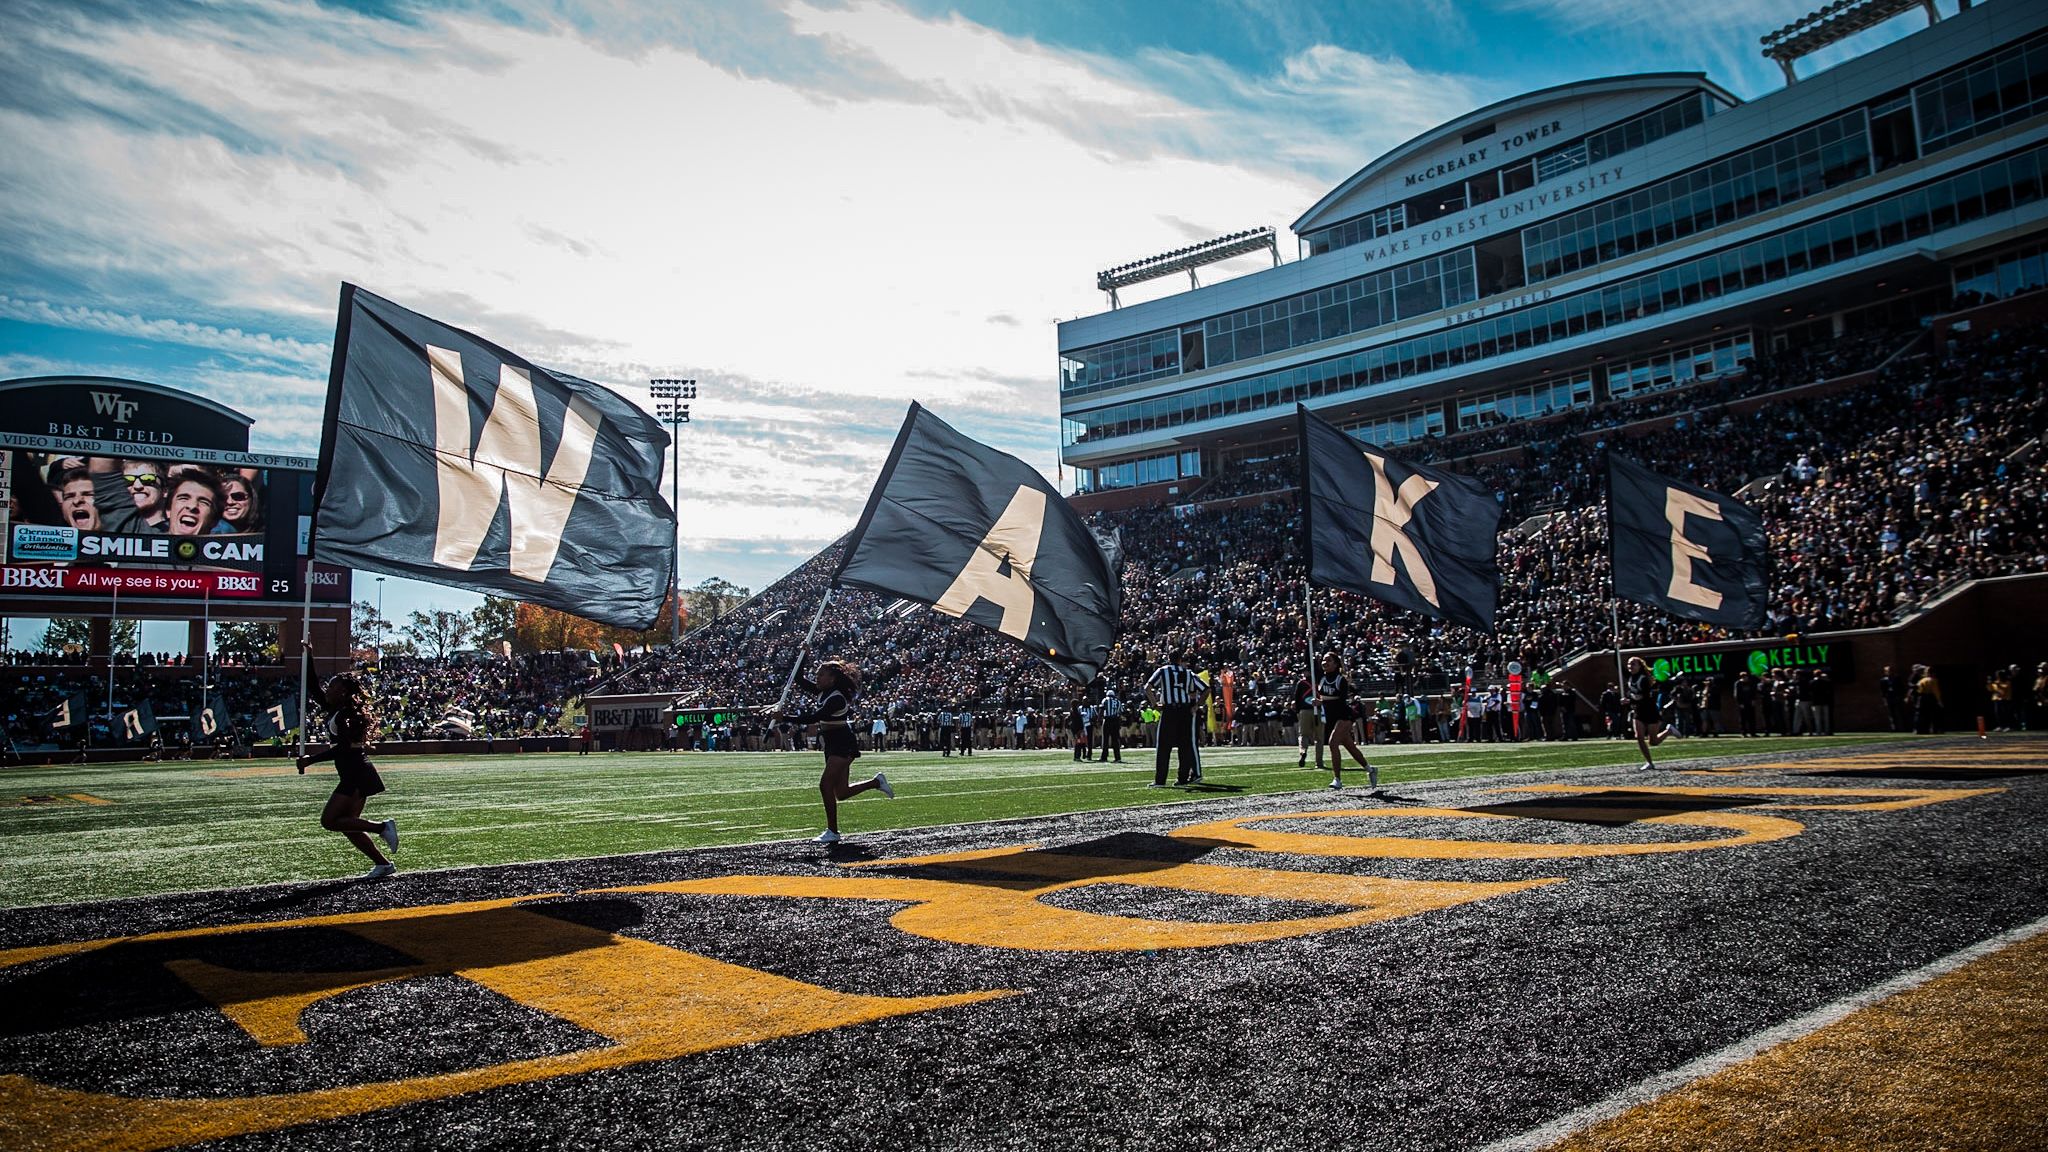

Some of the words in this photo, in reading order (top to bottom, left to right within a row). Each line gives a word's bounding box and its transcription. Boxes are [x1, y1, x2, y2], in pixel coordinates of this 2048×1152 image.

[1404, 148, 1488, 187] McCREARY
[1501, 120, 1562, 152] TOWER
[1363, 238, 1411, 263] WAKE
[1420, 213, 1489, 246] FOREST
[1499, 167, 1625, 220] UNIVERSITY
[1446, 307, 1487, 326] BB&T
[1501, 289, 1552, 311] FIELD
[90, 391, 139, 424] WF
[48, 422, 104, 438] BB&T
[116, 428, 174, 444] FIELD
[3, 434, 48, 447] VIDEO
[55, 439, 102, 451] BOARD
[113, 443, 185, 458] HONORING
[192, 450, 217, 461] THE
[224, 453, 259, 464] CLASS
[264, 456, 280, 466] OF
[285, 458, 309, 468] 1961
[426, 344, 601, 584] W
[19, 528, 60, 536] Chermak
[29, 535, 65, 543] Hanson
[1363, 451, 1440, 608] K
[81, 536, 169, 558] SMILE
[202, 541, 264, 561] CAM
[933, 483, 1047, 642] A
[1665, 486, 1723, 610] E
[1, 568, 69, 588] BB&T
[77, 573, 97, 586] All
[100, 577, 122, 586] we
[126, 575, 152, 588] see
[155, 574, 167, 588] is
[217, 576, 260, 591] BB&T
[271, 580, 289, 593] 25
[1671, 654, 1723, 674] KELLY
[1769, 645, 1829, 666] KELLY
[593, 709, 632, 726] BB&T
[633, 707, 663, 725] FIEL
[684, 713, 706, 723] KELLY
